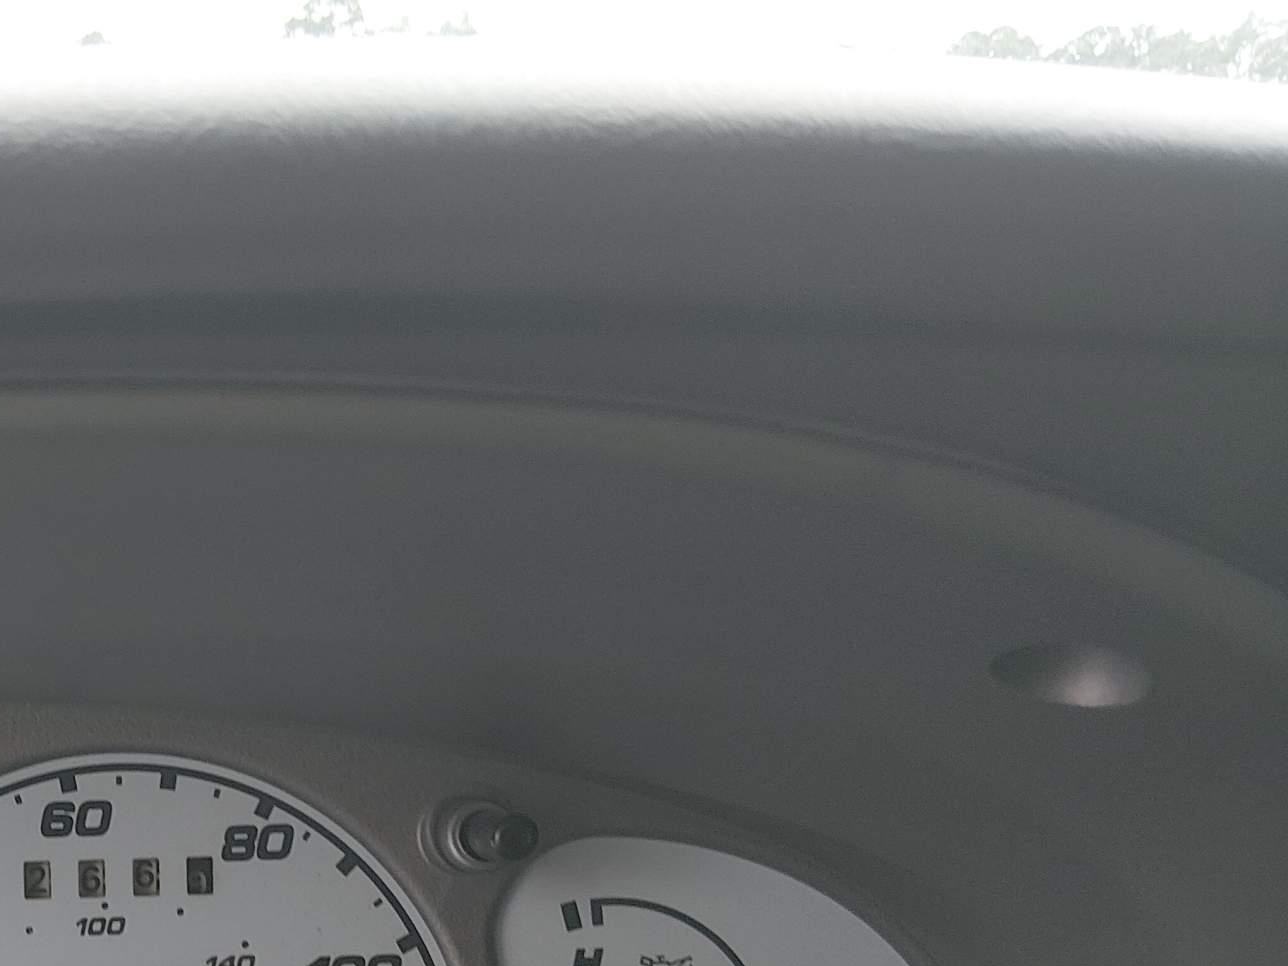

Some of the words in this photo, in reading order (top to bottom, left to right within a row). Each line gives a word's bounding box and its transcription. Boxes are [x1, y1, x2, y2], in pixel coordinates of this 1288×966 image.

[40, 800, 113, 838] 60
[220, 824, 295, 861] 80
[76, 916, 126, 936] 100
